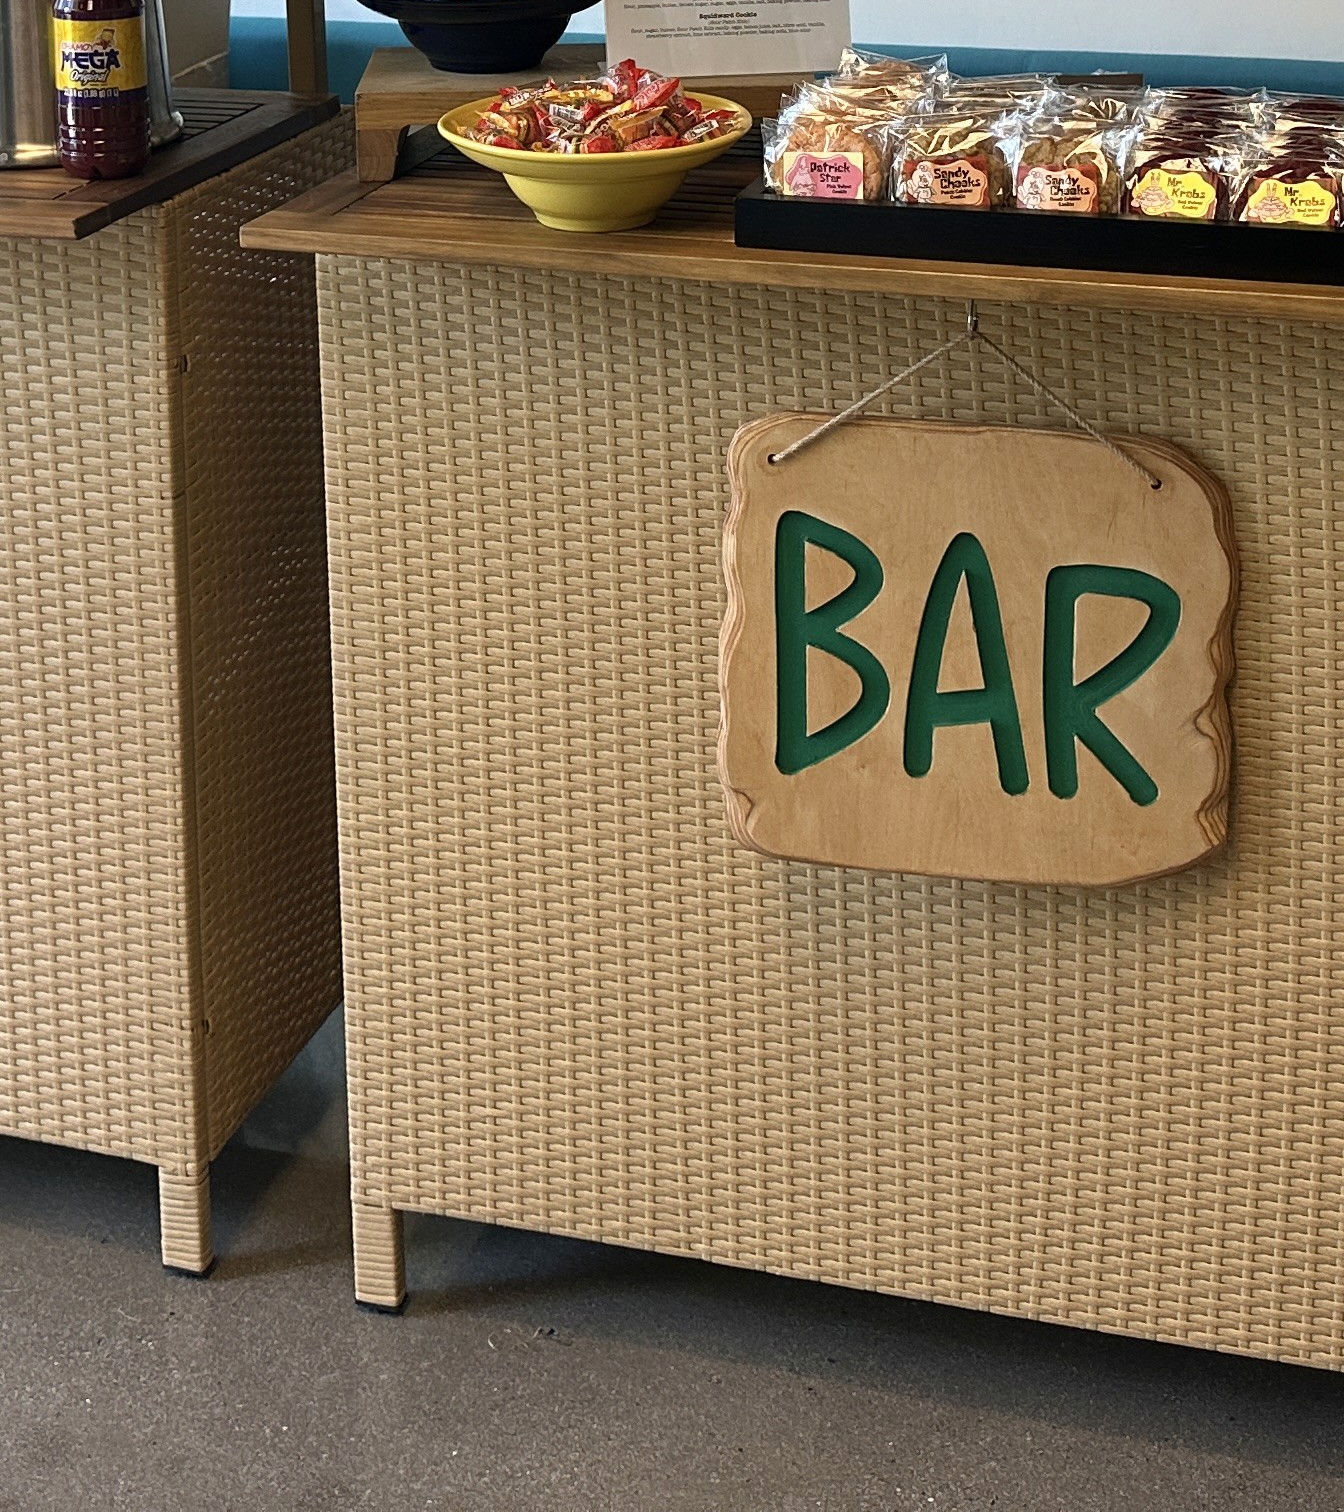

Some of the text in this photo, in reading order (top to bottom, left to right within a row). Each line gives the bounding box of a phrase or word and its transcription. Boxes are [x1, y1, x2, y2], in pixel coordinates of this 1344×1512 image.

[61, 49, 121, 72] MEGA
[69, 69, 111, 86] Original
[810, 161, 850, 173] Patrick
[933, 166, 970, 179] Sandy
[819, 173, 841, 183] Star
[940, 177, 981, 189] Cheeks
[1045, 173, 1080, 187] Sandy
[1167, 177, 1185, 188] Mr.
[1171, 187, 1206, 199] Krabs
[1284, 186, 1303, 197] Mr.
[1290, 196, 1326, 207] Krabs
[774, 509, 1182, 808] BAR
